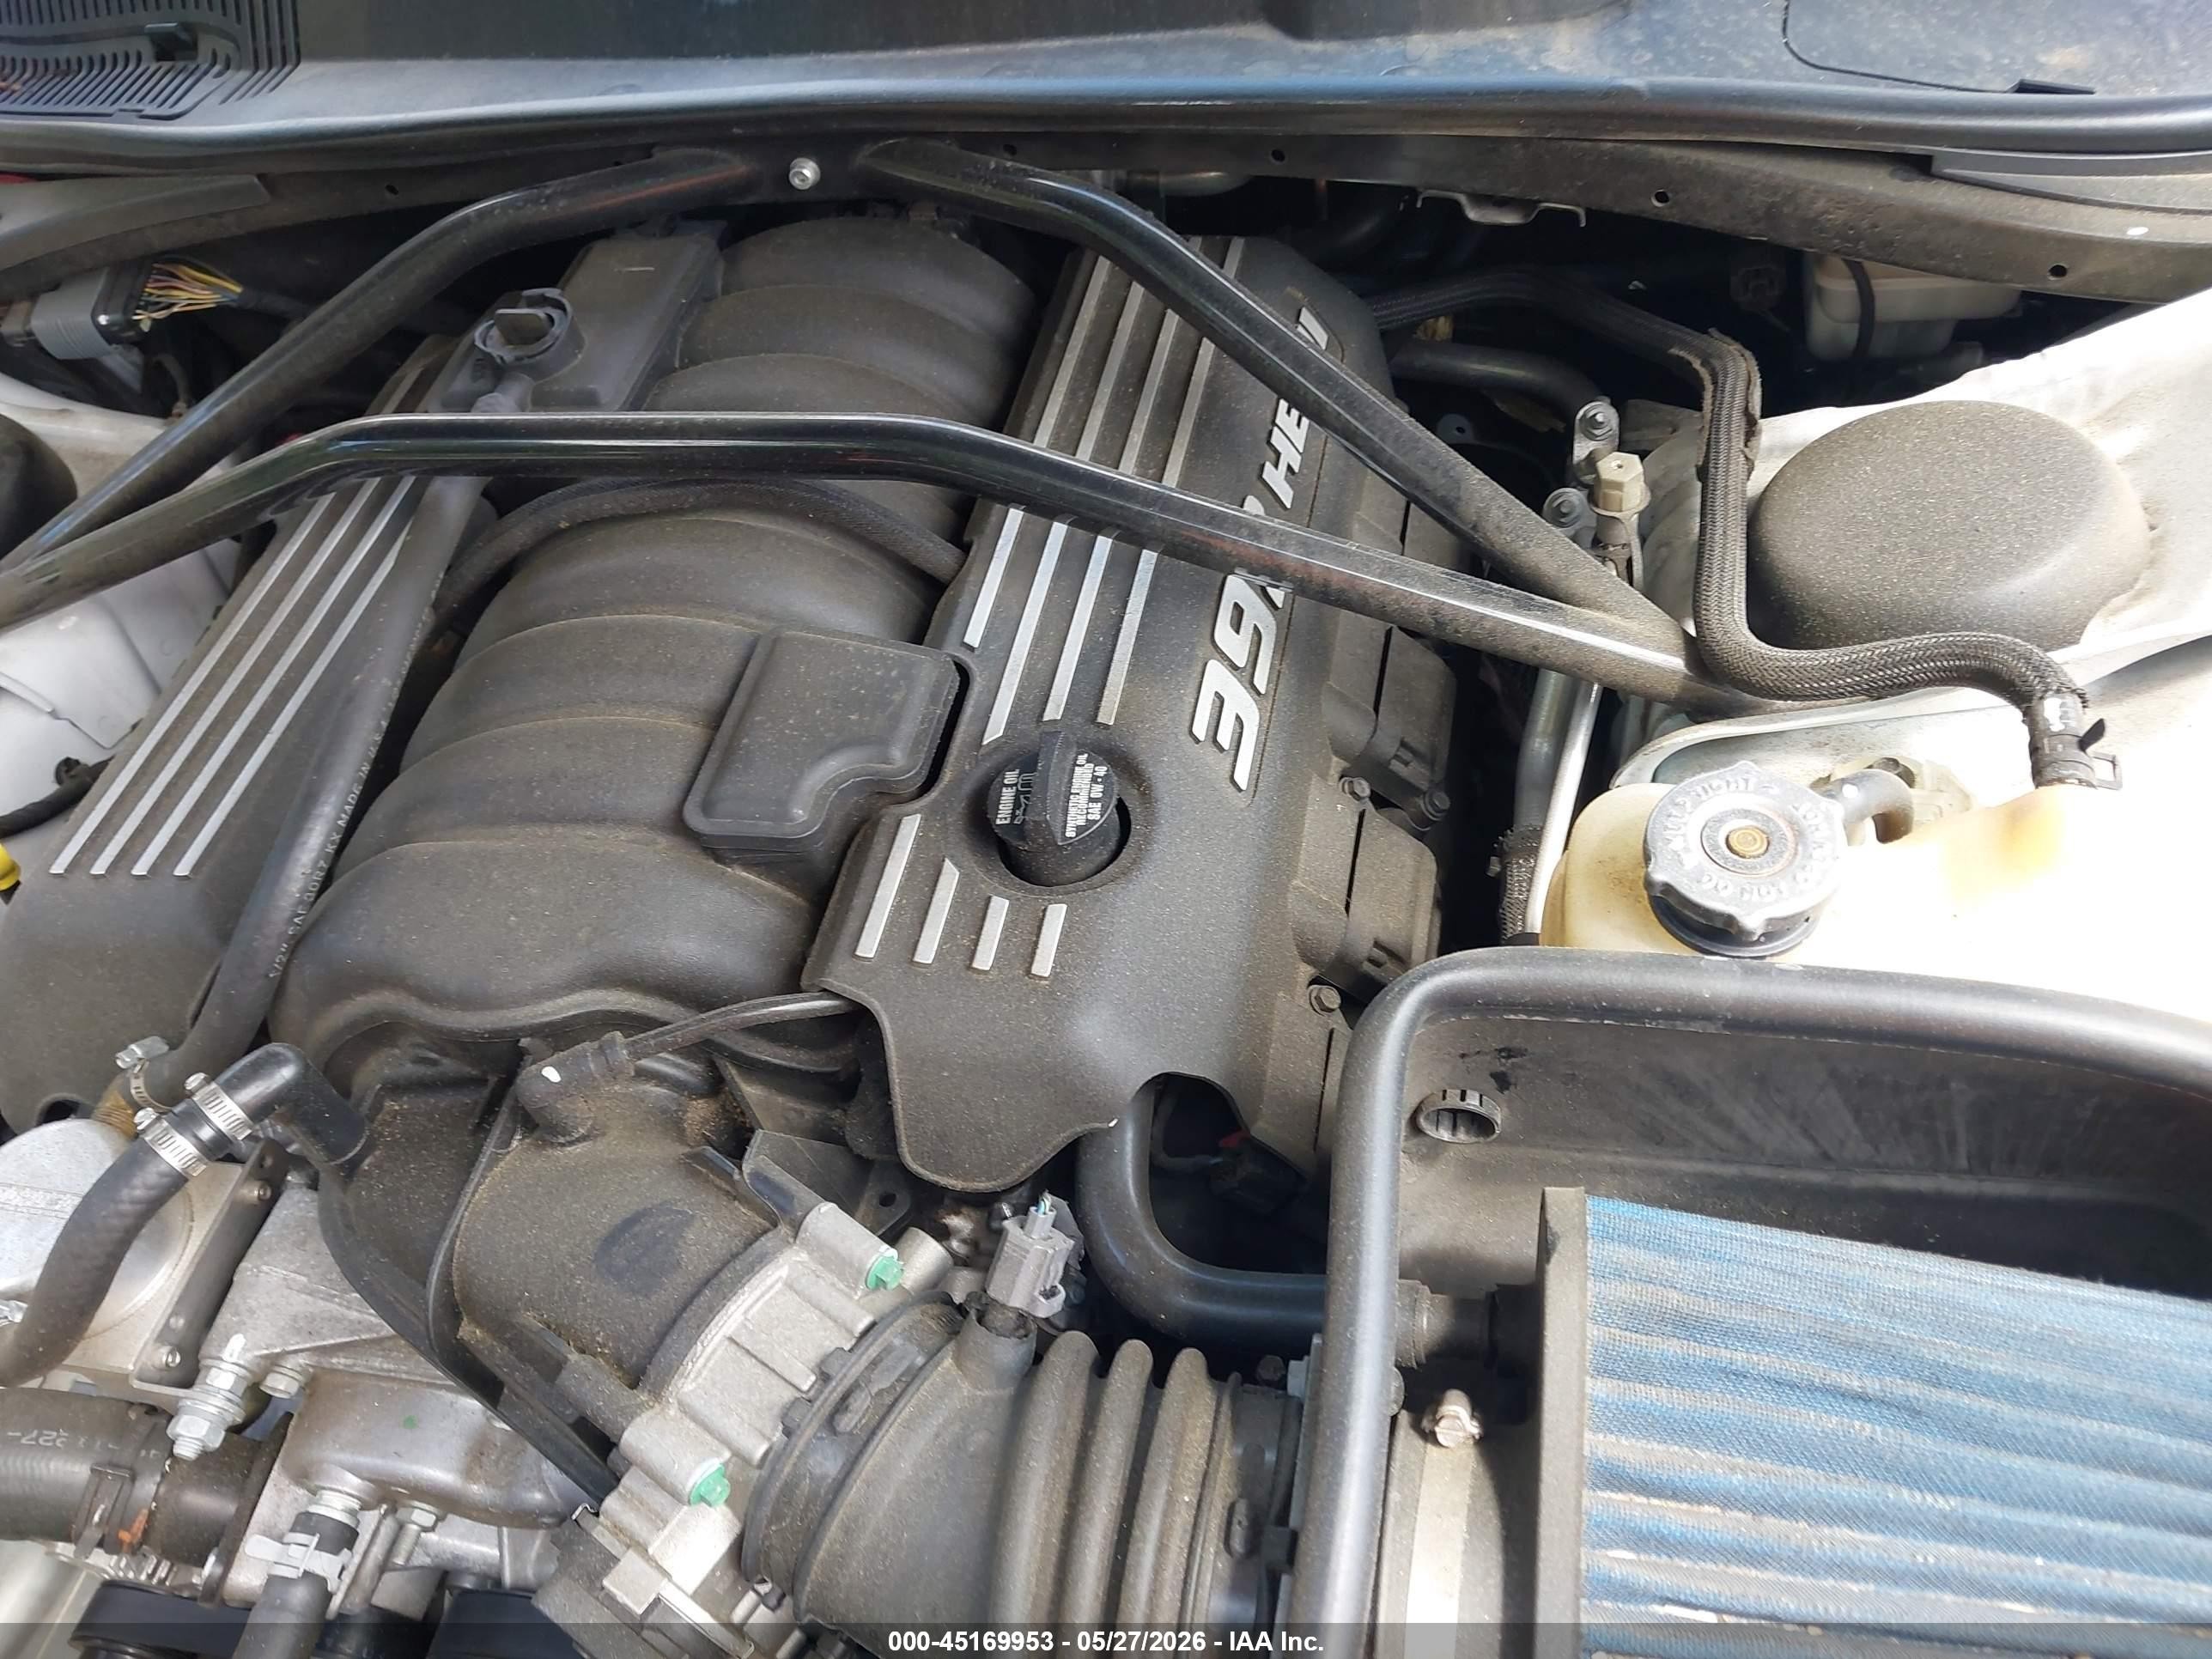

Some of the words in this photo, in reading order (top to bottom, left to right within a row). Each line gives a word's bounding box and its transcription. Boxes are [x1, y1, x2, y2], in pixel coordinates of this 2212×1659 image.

[1261, 307, 1329, 509] HEI
[1003, 769, 1020, 785] OIL
[1065, 793, 1080, 838] SYNTHETIC
[1075, 752, 1089, 766] OIL
[337, 782, 362, 828] MADE
[995, 786, 1018, 825] ENGINE
[1086, 802, 1103, 821] SAE
